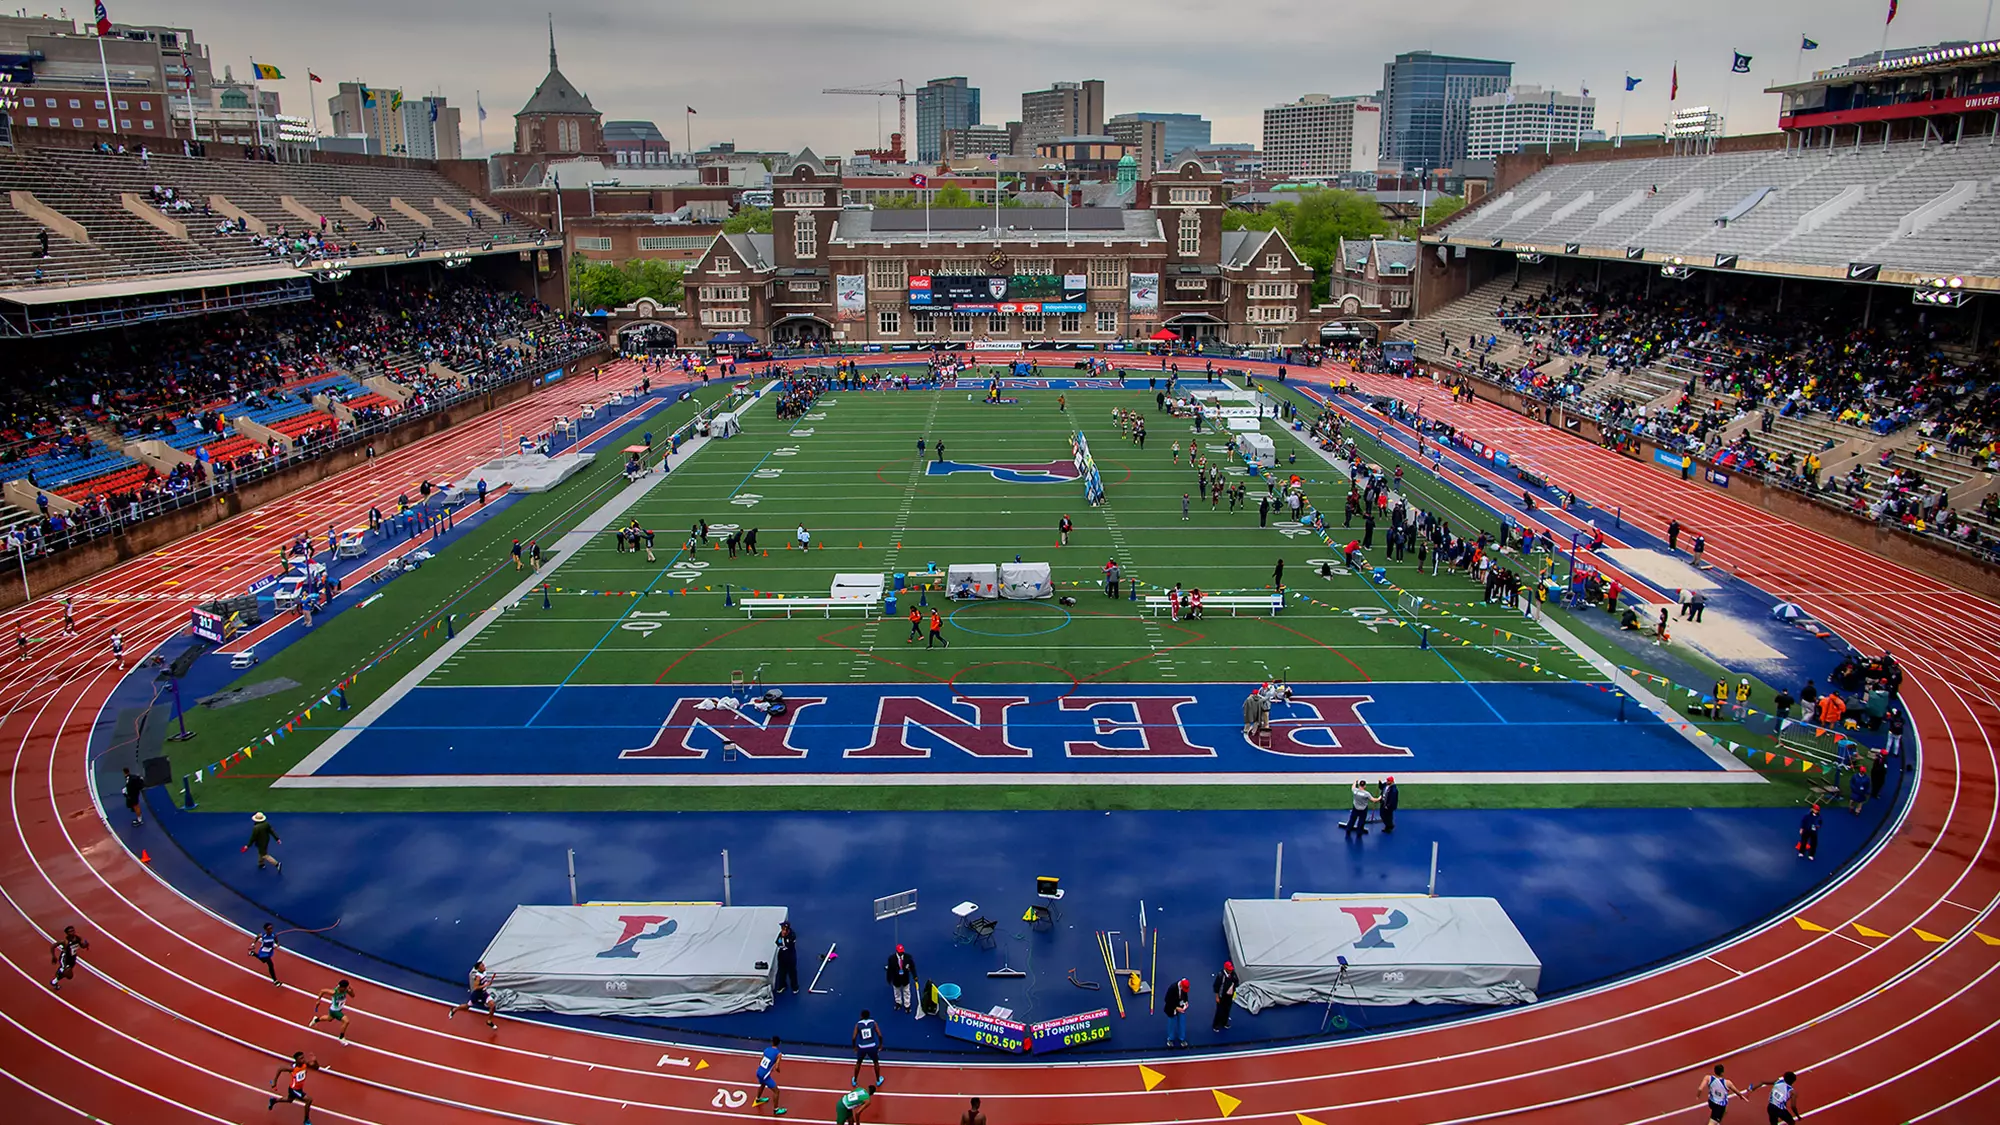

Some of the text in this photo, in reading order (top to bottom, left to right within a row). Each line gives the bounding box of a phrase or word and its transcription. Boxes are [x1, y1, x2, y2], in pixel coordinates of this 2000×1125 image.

[1965, 96, 2000, 108] UNIVER
[1014, 268, 1052, 276] FIELD
[621, 610, 671, 631] 10
[618, 695, 1414, 758] PENN
[595, 914, 679, 959] P
[1339, 905, 1410, 950] P
[948, 1014, 1005, 1034] 13 TOMPKINS
[1032, 1023, 1044, 1032] CM
[1033, 1020, 1091, 1040] 13 TOMPKINS
[656, 1053, 692, 1068] 1
[711, 1087, 748, 1109] 2
